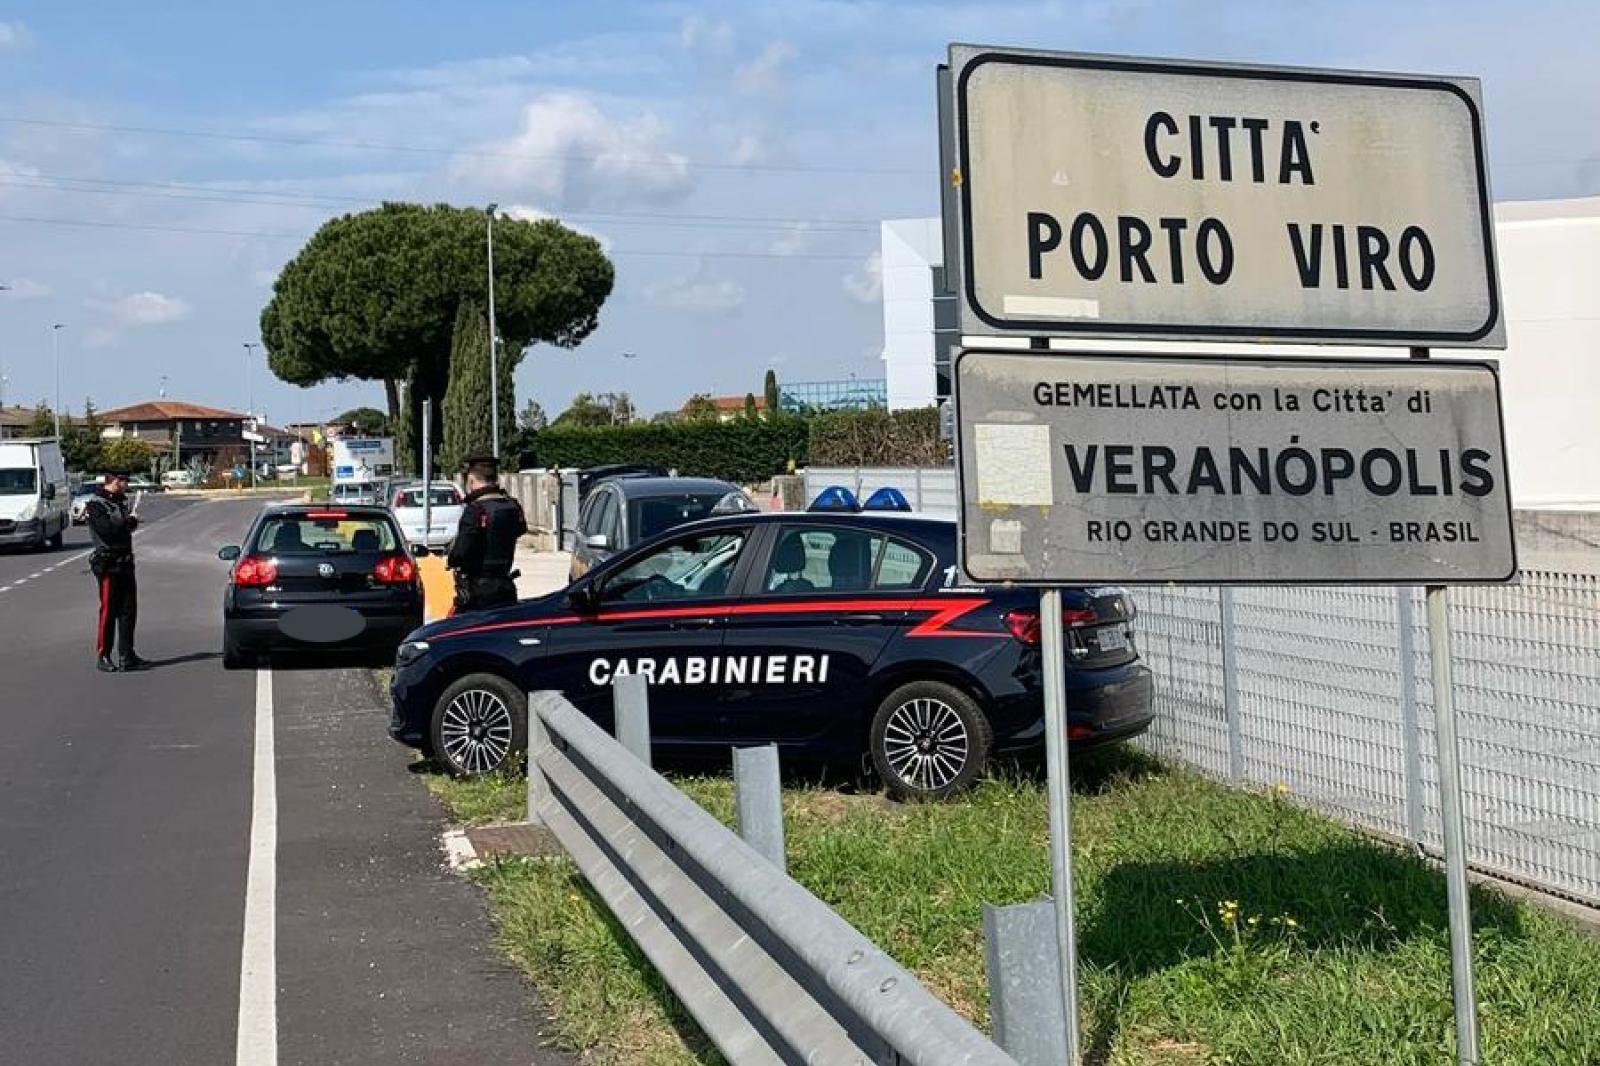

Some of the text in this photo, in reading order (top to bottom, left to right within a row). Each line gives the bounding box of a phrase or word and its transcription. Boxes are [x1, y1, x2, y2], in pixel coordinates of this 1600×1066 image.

[1027, 211, 1436, 292] PORTO VIRO
[1033, 381, 1201, 411] GEMELLATA
[1213, 392, 1262, 412] con
[1273, 387, 1301, 412] la
[1407, 390, 1432, 414] di
[1064, 435, 1494, 497] VERANÓPOLIS
[1087, 520, 1132, 543] RIO
[1142, 520, 1253, 543] GRANDE
[1262, 520, 1300, 544] DO
[1311, 521, 1361, 544] SUL
[1389, 521, 1480, 544] BRASIL
[588, 655, 830, 685] CARABINIERI
